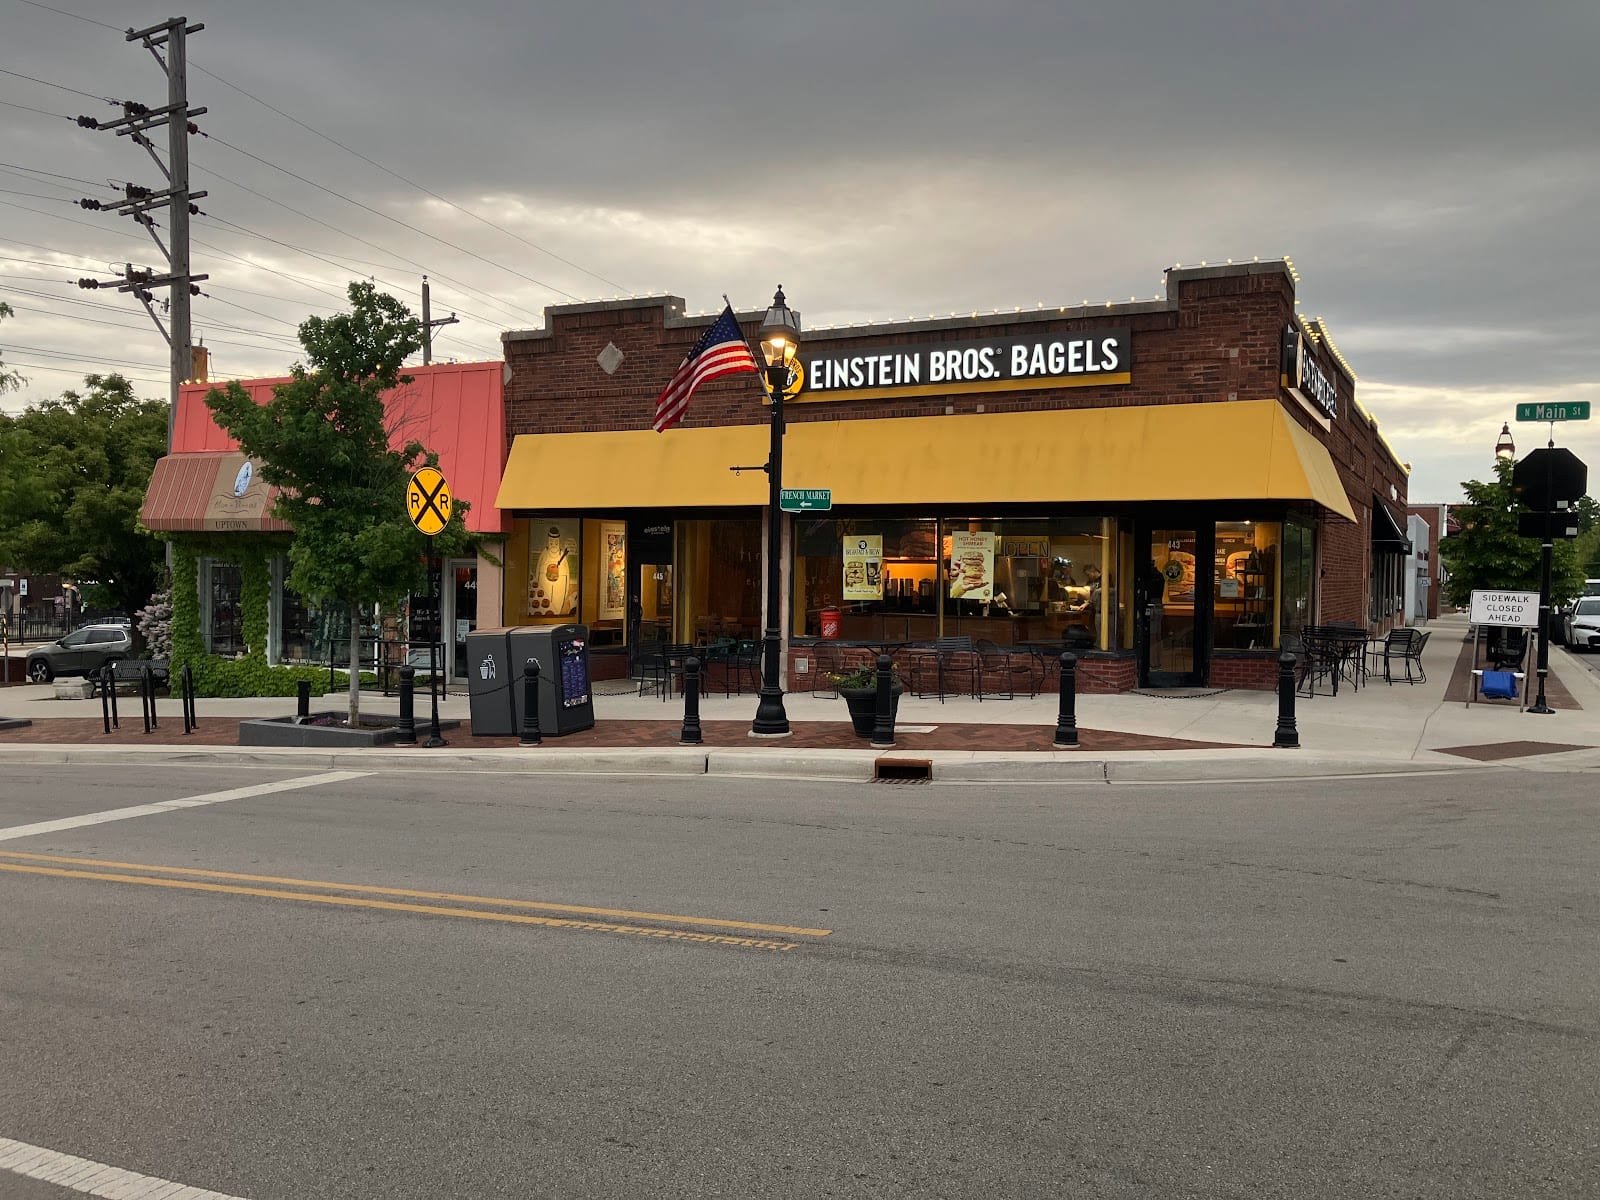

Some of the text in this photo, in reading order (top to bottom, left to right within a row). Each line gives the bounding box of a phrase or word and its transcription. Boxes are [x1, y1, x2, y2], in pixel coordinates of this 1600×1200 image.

[810, 353, 920, 389] EINSTEIN
[1010, 338, 1118, 376] BAGELS
[1525, 405, 1580, 419] N Main St
[781, 490, 830, 500] FRENCH MARKET
[215, 521, 248, 529] UPTOWN
[1168, 540, 1180, 550] 443
[464, 580, 478, 590] 44
[1482, 594, 1529, 603] SIDEWALK
[1486, 604, 1523, 613] CLOSED
[1488, 614, 1521, 622] AHEAD
